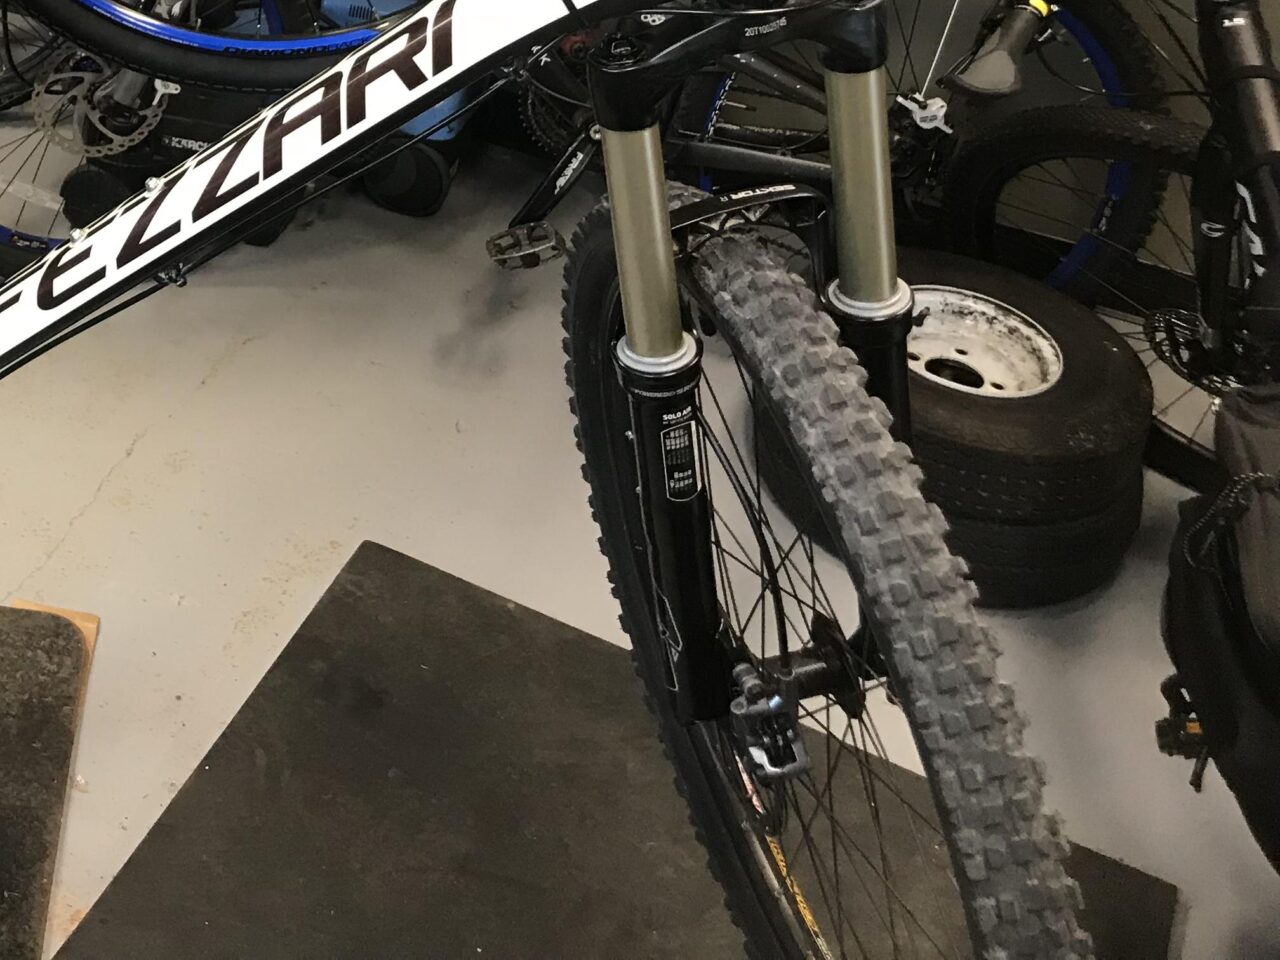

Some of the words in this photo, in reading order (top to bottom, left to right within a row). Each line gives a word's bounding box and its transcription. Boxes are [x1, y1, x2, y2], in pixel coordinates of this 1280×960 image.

[731, 184, 796, 200] SEKTOR
[662, 411, 681, 421] SOLO
[682, 406, 692, 416] AIR
